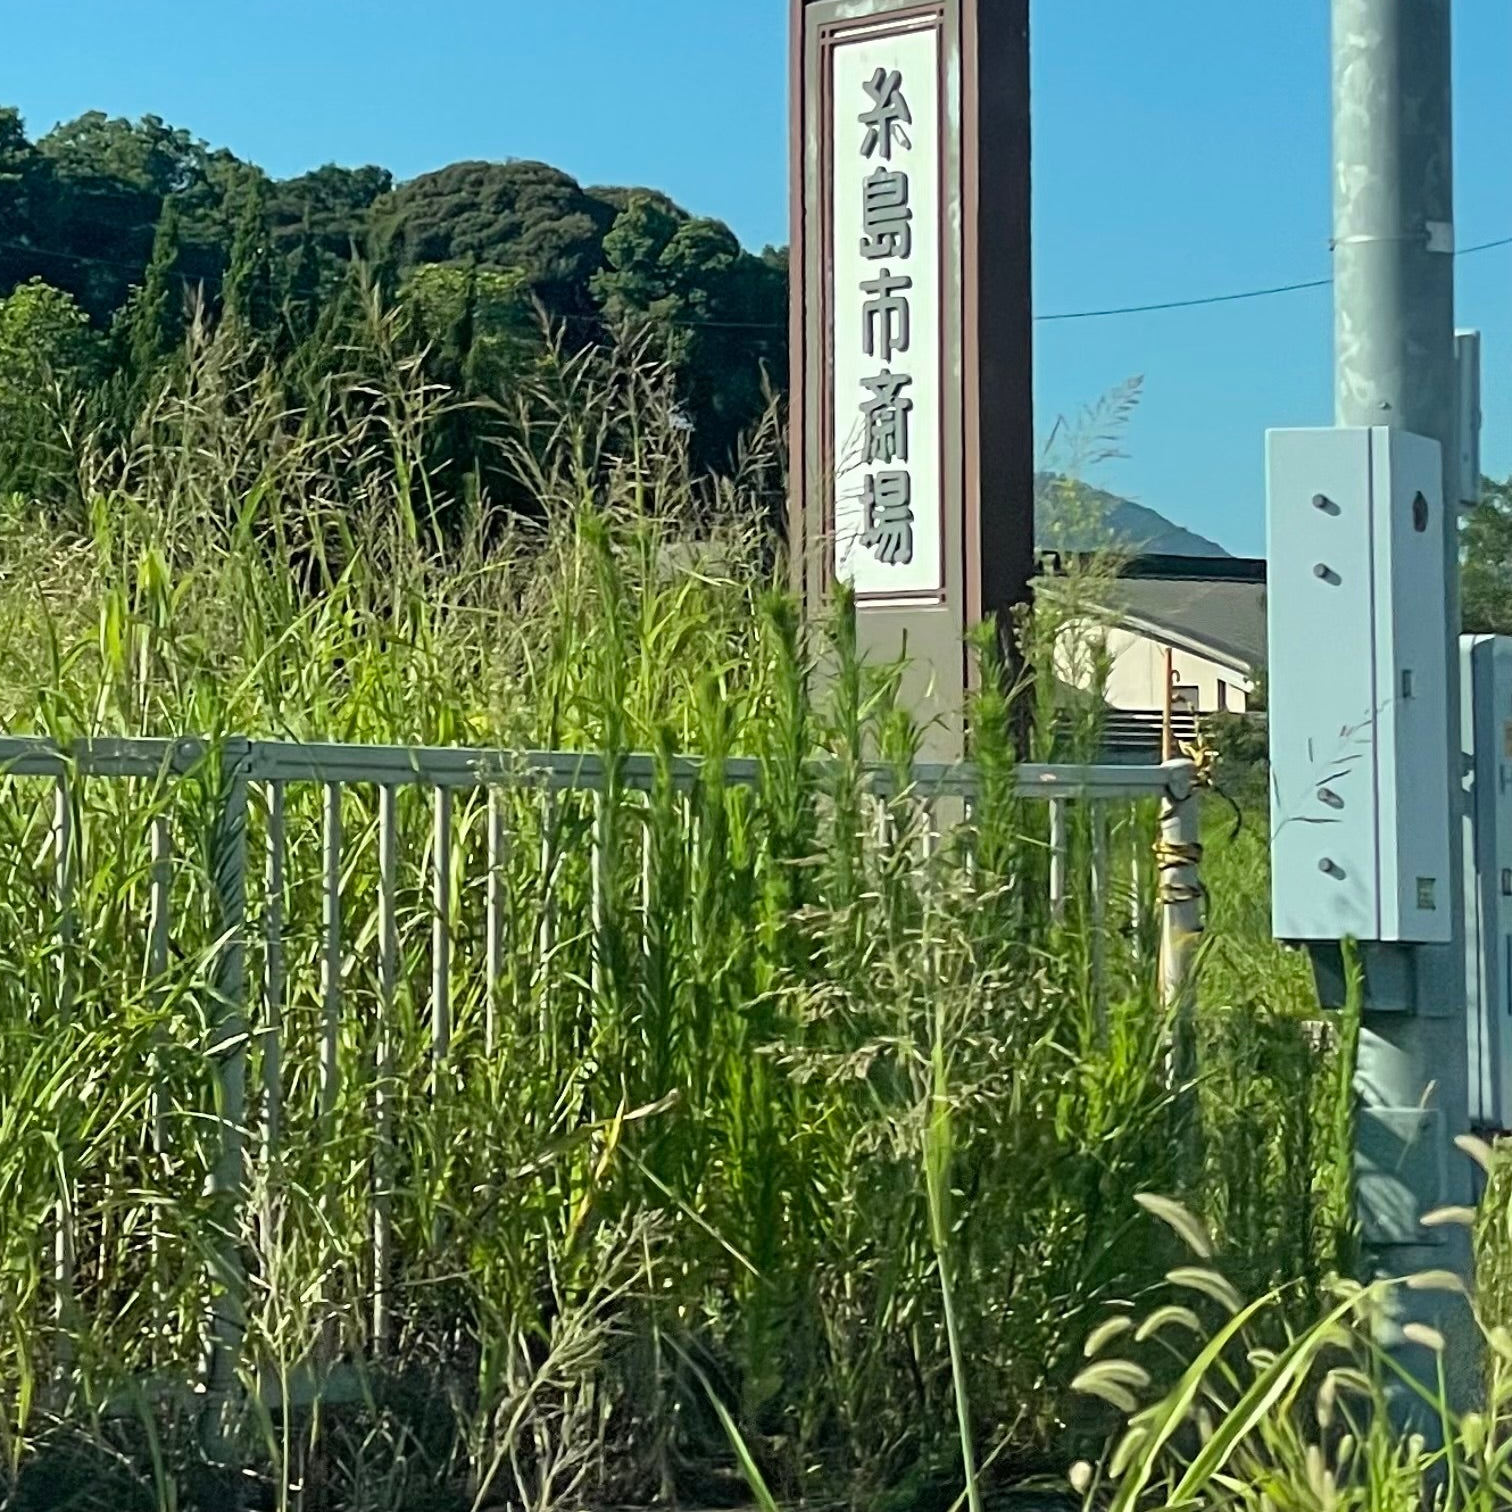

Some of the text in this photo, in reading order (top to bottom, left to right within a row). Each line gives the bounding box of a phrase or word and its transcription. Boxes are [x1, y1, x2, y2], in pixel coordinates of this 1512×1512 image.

[858, 67, 914, 566] 糸島市斎場
